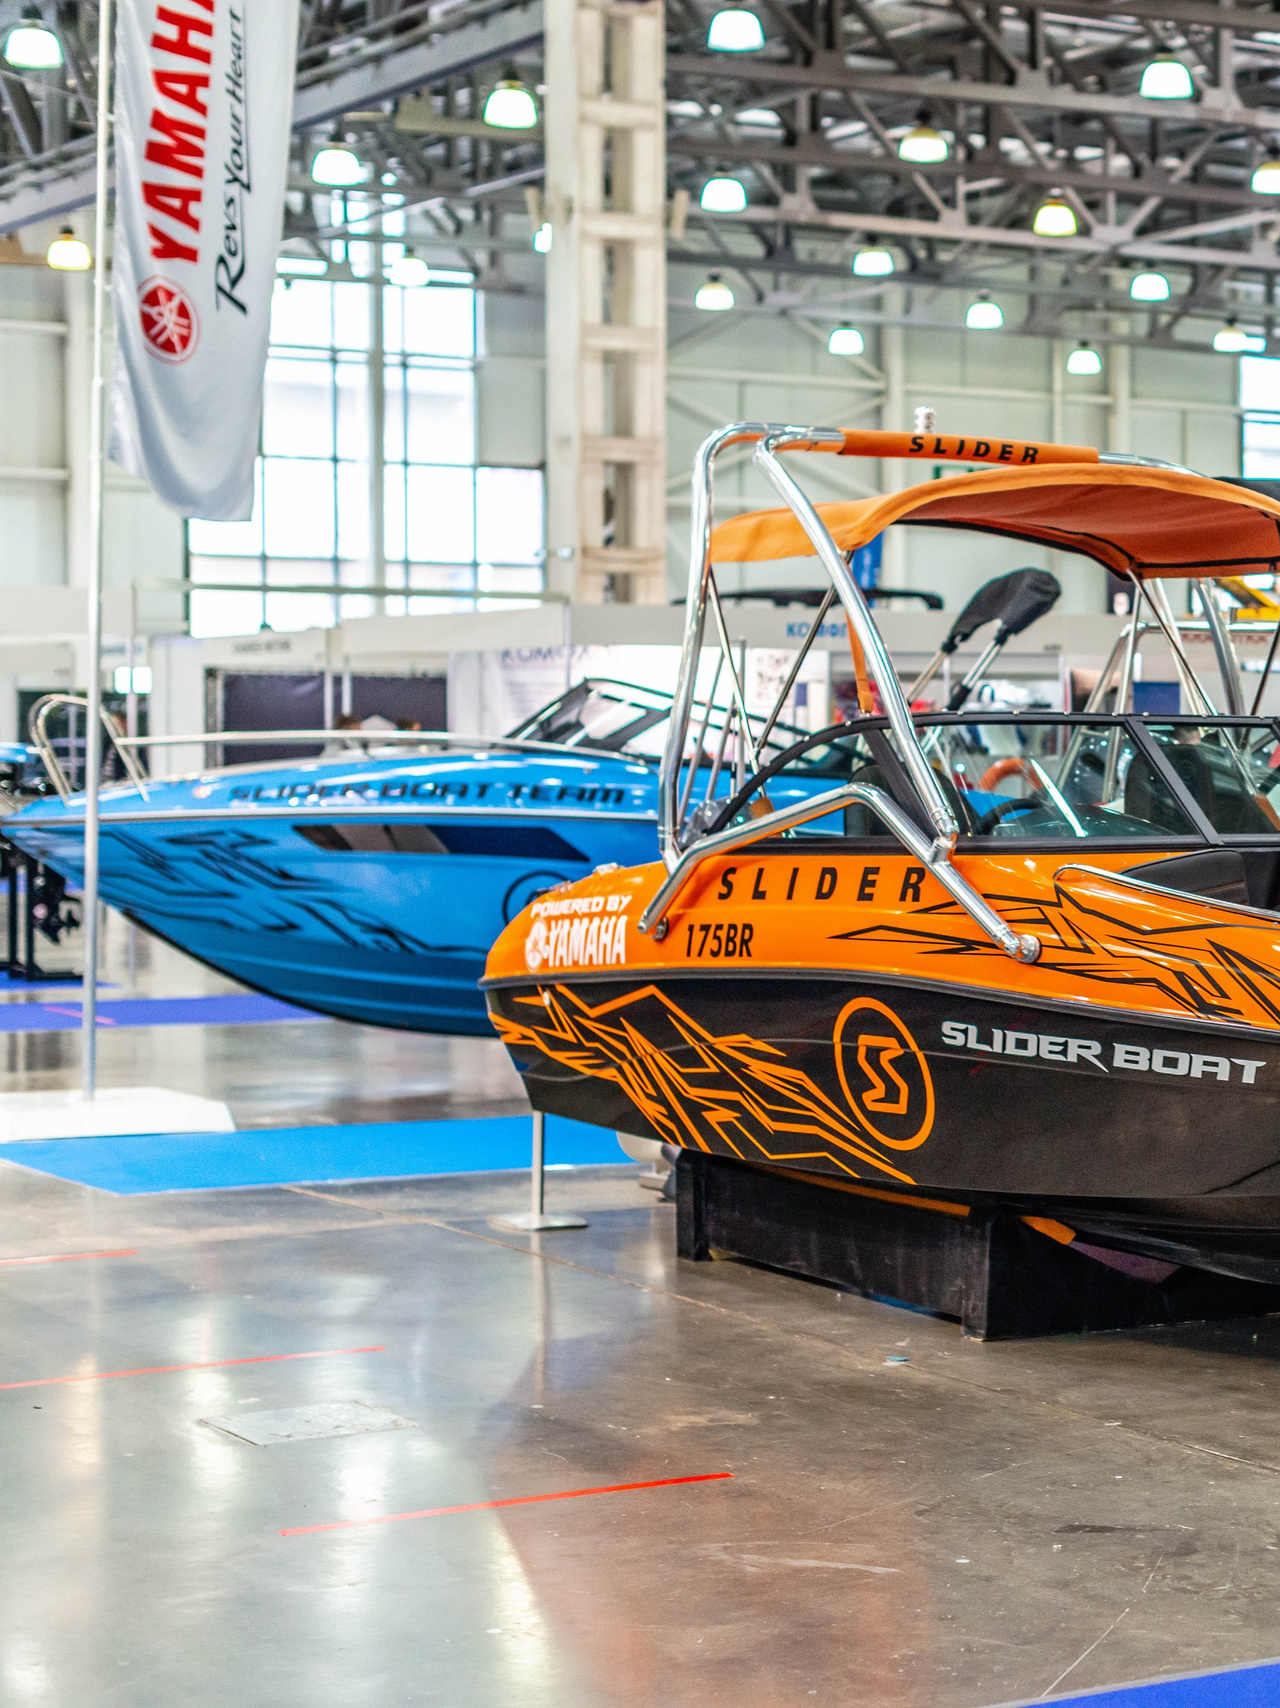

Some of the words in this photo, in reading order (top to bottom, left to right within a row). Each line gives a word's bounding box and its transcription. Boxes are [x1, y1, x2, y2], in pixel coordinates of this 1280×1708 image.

[225, 4, 244, 103] Heart
[142, 0, 216, 264] YAMAH
[223, 108, 250, 194] Your
[214, 190, 247, 317] Revs
[909, 436, 1039, 464] SLIDER
[510, 783, 626, 804] TEAM
[530, 896, 603, 919] POWERED
[606, 894, 633, 913] BY
[717, 866, 927, 903] SLIDER
[547, 915, 628, 968] YAMAHA
[685, 923, 755, 958] 175BR
[941, 1021, 1110, 1073] SLIDER
[1111, 1042, 1267, 1084] BOAT
